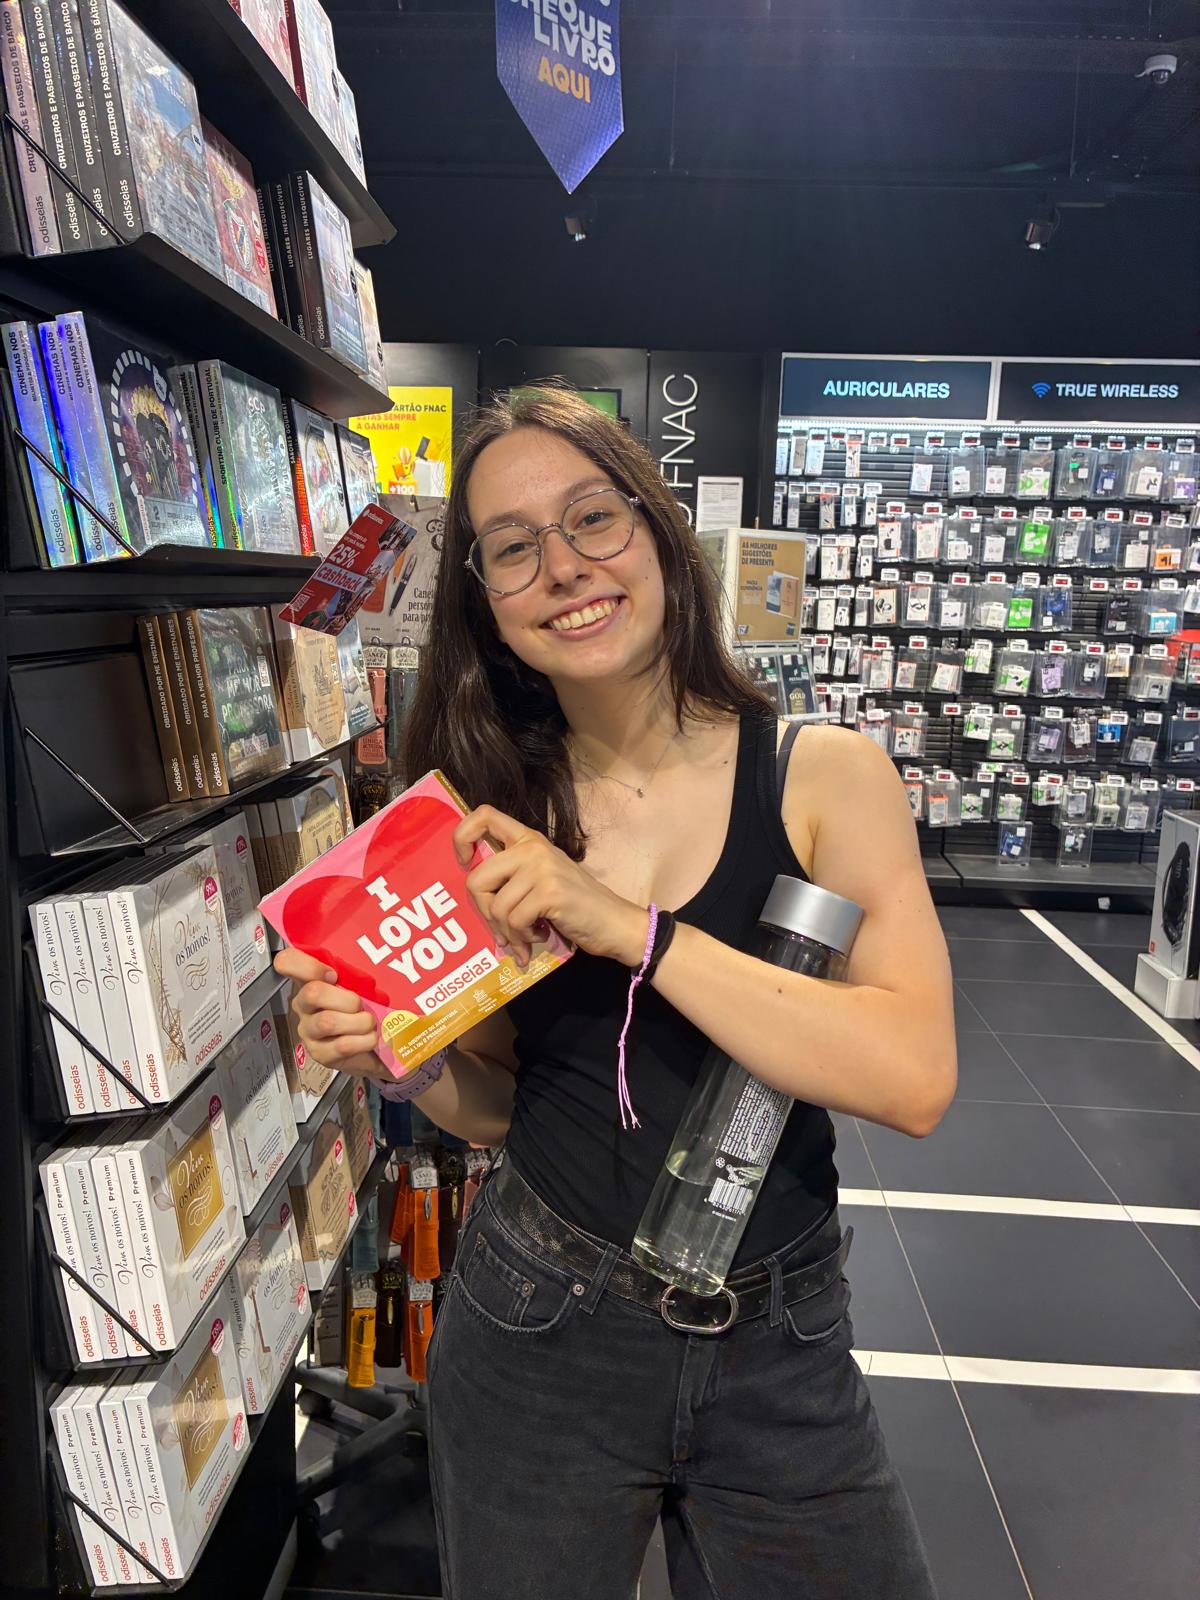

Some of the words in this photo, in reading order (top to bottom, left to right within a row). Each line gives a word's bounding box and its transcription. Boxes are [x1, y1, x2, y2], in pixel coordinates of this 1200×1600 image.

[4, 11, 15, 44] BARCO
[34, 6, 46, 40] BARCO
[61, 2, 72, 34] BARCO
[96, 27, 104, 40] DE
[511, 0, 612, 51] EQUE
[9, 45, 18, 58] DE
[39, 40, 48, 54] DE
[67, 36, 76, 50] DE
[534, 13, 615, 75] LIVRO
[42, 56, 57, 104] PASSEIOS
[69, 52, 84, 100] PASSEIOS
[96, 42, 112, 91] PASSEIOS
[538, 55, 591, 103] AQUI
[12, 61, 26, 109] PASSEIOS
[52, 113, 67, 169] CRUZEIROS
[79, 109, 94, 166] CRUZEIROS
[106, 100, 121, 156] CRUZEIROS
[36, 196, 49, 243] odisseias
[66, 192, 80, 240] odisseias
[120, 180, 134, 228] odisseias
[304, 230, 314, 260] LUGARES
[65, 324, 74, 344] NOS
[316, 306, 326, 340] odisseias
[8, 331, 18, 352] NOS
[48, 332, 56, 350] NOS
[14, 352, 28, 395] CINEMAS
[52, 353, 66, 394] CINEMAS
[70, 346, 84, 388] CINEMAS
[205, 368, 216, 408] PORTUGAL
[824, 380, 950, 399] AURICULARES
[1056, 383, 1097, 397] TRUE
[1100, 383, 1178, 398] WIRELESS
[211, 409, 218, 420] DE
[660, 374, 698, 488] FNAC
[213, 420, 222, 444] CLUBE
[216, 446, 227, 484] SPORTING
[51, 509, 66, 552] odisseias
[330, 544, 360, 569] 25%
[316, 566, 362, 591] cashback
[403, 614, 419, 623] para
[186, 616, 199, 663] PROFESSORA
[154, 665, 160, 674] ME
[195, 664, 205, 692] MELHOR
[160, 691, 171, 728] OBRIGADO
[181, 687, 191, 725] OBRIGADO
[201, 700, 209, 718] PARA
[170, 757, 183, 792] odisseias
[191, 754, 204, 789] odisseias
[210, 752, 223, 787] odisseias
[365, 876, 400, 912] I
[38, 912, 54, 945] noivos!
[65, 911, 80, 944] noivos!
[92, 907, 108, 940] noivos!
[117, 900, 132, 933] noivos!
[356, 881, 458, 966] LOVE
[49, 948, 56, 957] os
[74, 946, 82, 956] os
[102, 943, 110, 952] os
[126, 936, 134, 946] os
[176, 951, 186, 966] os
[185, 926, 211, 959] noivos!
[387, 917, 467, 984] YOU
[425, 956, 492, 1009] odisseias
[386, 1014, 405, 1030] 800
[195, 1031, 222, 1066] odisseias
[400, 1046, 413, 1057] PARA
[70, 1064, 85, 1109] odisseias
[96, 1063, 112, 1108] odisseias
[147, 1054, 160, 1098] odisseias
[53, 1172, 63, 1209] Premium
[78, 1168, 89, 1205] Premium
[104, 1164, 115, 1201] Premium
[128, 1158, 140, 1194] Premium
[179, 1193, 188, 1209] os
[188, 1153, 213, 1197] noivos!
[57, 1213, 71, 1245] noivos!
[83, 1210, 96, 1244] noivos!
[108, 1206, 123, 1237] noivos!
[132, 1200, 147, 1232] noivos!
[66, 1246, 74, 1255] os
[118, 1238, 125, 1248] os
[142, 1233, 149, 1242] os
[200, 1255, 226, 1300] odisseias
[79, 1315, 94, 1357] odisseias
[104, 1312, 118, 1354] odisseias
[153, 1303, 167, 1346] odisseias
[247, 1377, 258, 1411] odisseias
[62, 1414, 74, 1448] Premium
[86, 1412, 98, 1446] Premium
[111, 1410, 123, 1444] Premium
[136, 1404, 147, 1438] Premium
[68, 1452, 83, 1479] noivos!
[91, 1451, 106, 1479] noivos!
[116, 1449, 131, 1477] noivos!
[140, 1444, 155, 1473] noivos!
[80, 1481, 86, 1490] os
[102, 1480, 109, 1489] os
[126, 1478, 133, 1487] os
[150, 1474, 157, 1483] os
[94, 1544, 109, 1582] odisseias
[161, 1537, 175, 1576] odisseias
